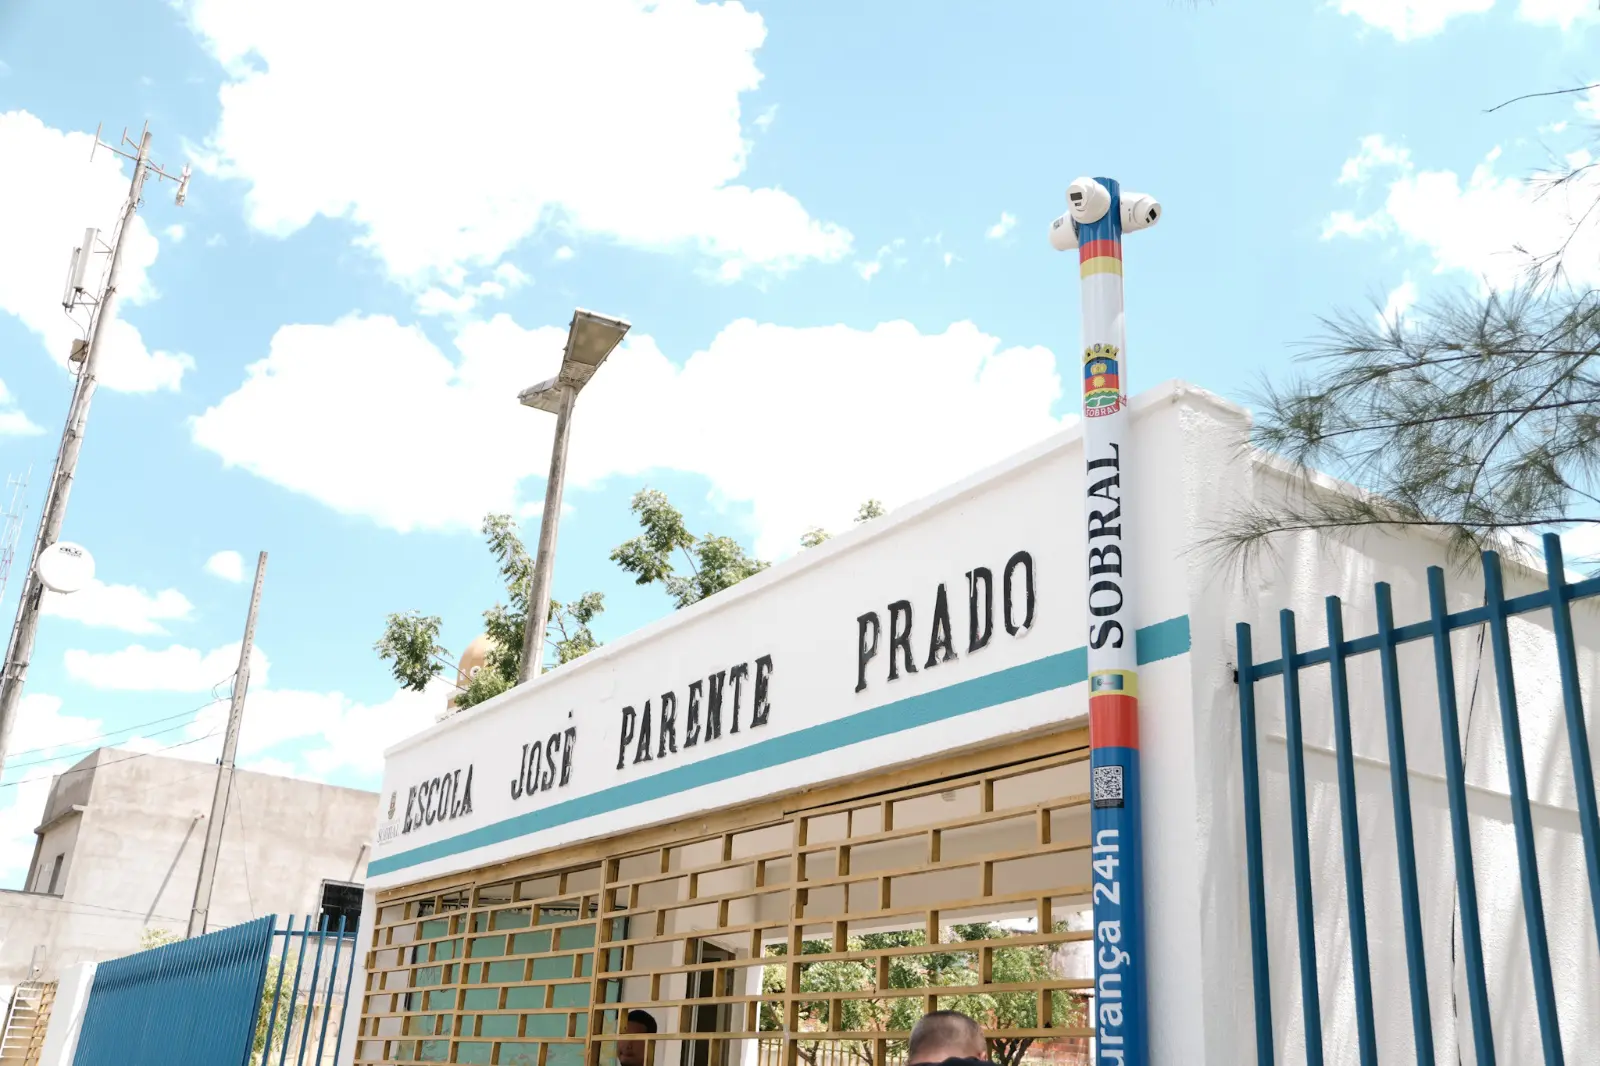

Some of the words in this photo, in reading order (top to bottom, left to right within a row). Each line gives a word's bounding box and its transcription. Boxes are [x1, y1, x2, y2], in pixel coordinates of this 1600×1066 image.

[1087, 442, 1124, 650] SOBRAL
[401, 763, 473, 834] ESCOLA
[616, 654, 774, 770] PARENTE
[855, 550, 1036, 693] PRADO
[1093, 829, 1121, 905] 24h
